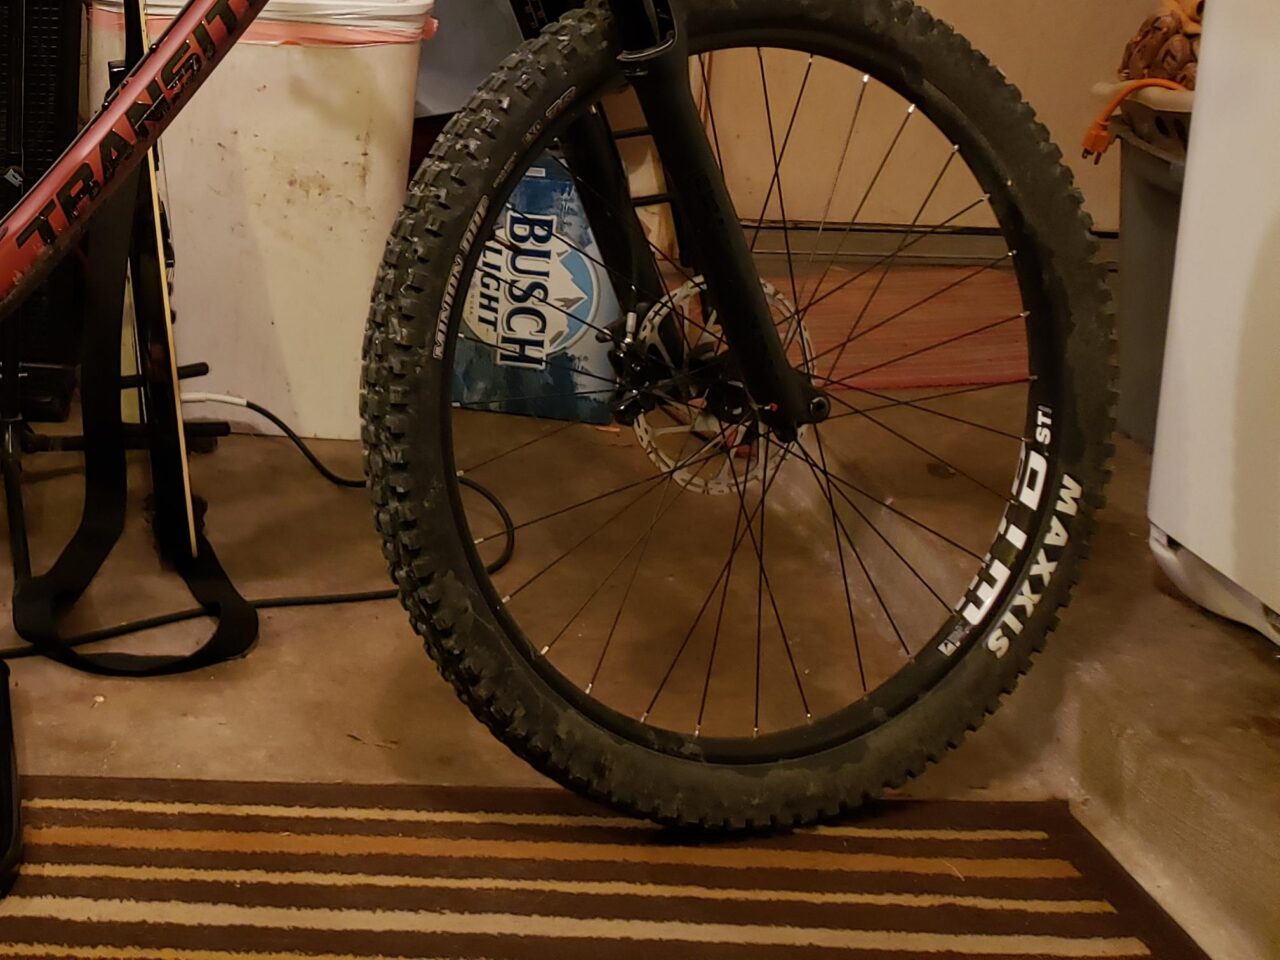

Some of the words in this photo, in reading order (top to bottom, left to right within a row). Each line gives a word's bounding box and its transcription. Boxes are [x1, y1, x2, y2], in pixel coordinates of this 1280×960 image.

[477, 240, 503, 333] LIGHT
[499, 214, 556, 369] BUSCH
[987, 473, 1083, 659] MAXXIS
